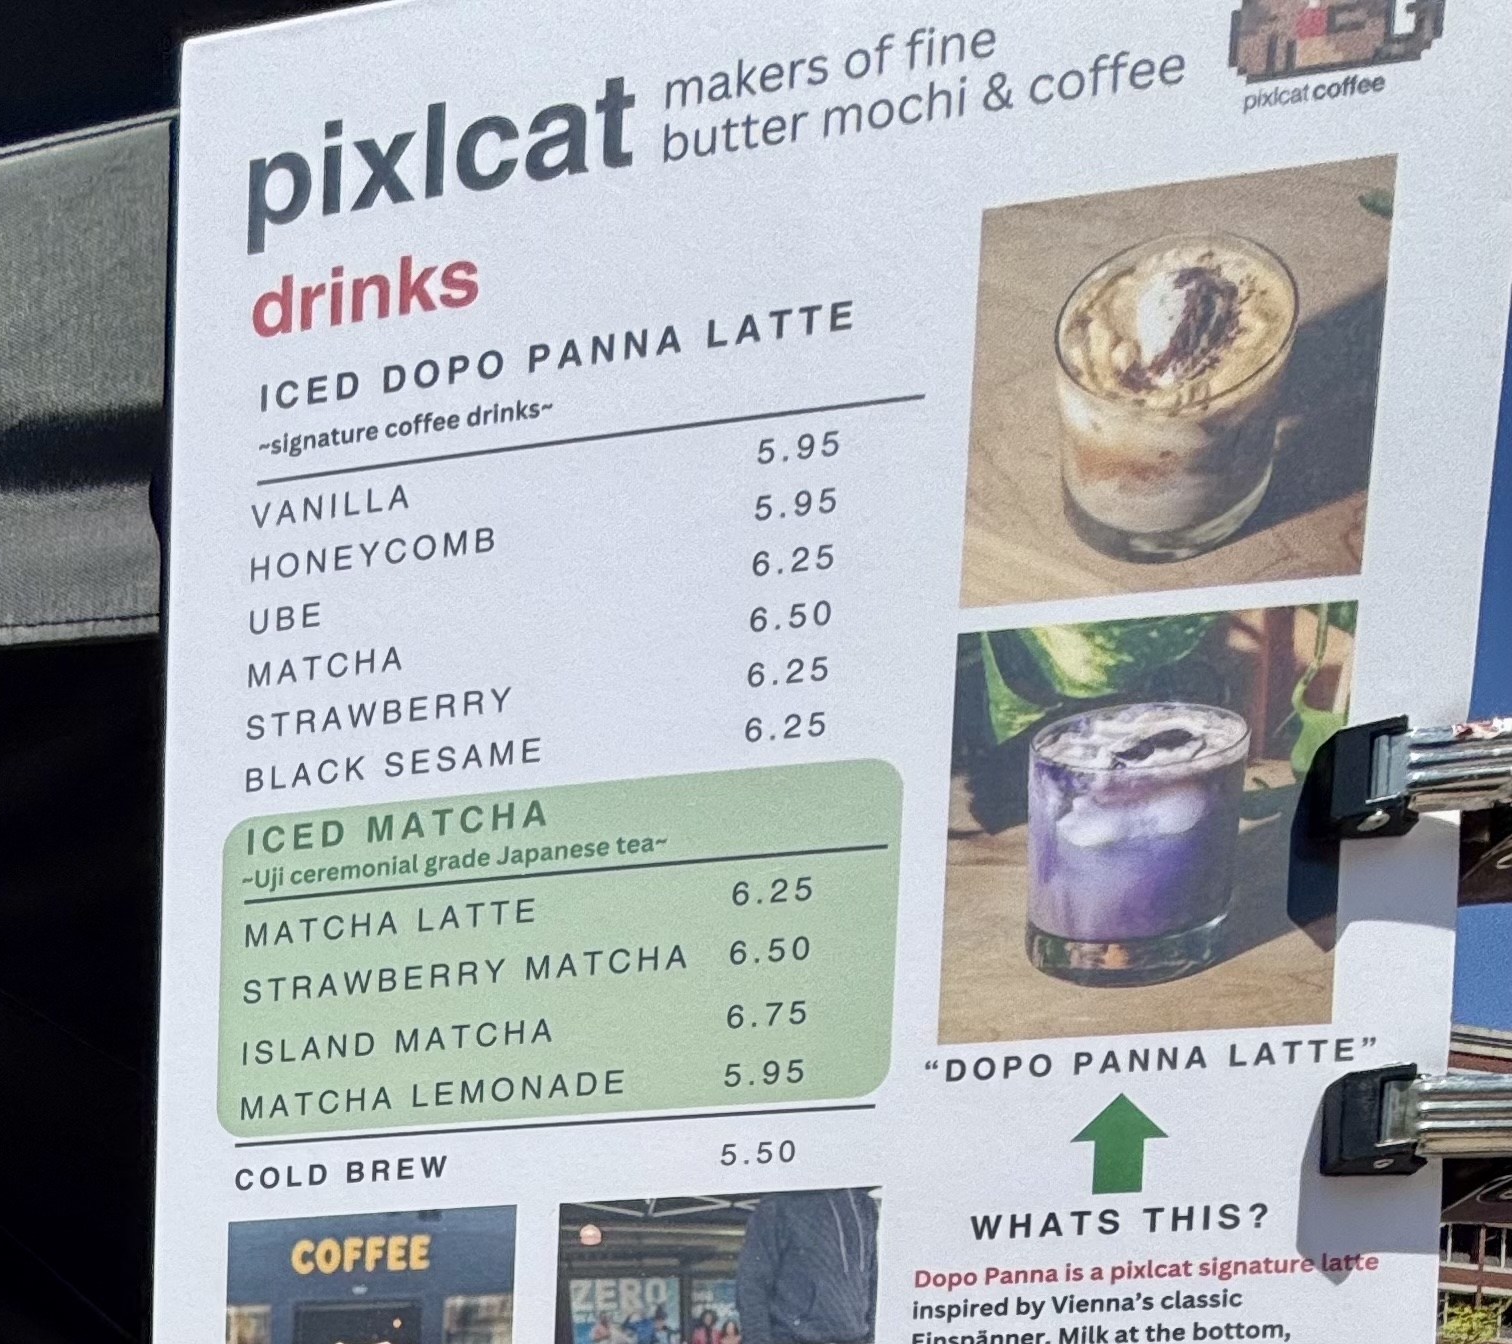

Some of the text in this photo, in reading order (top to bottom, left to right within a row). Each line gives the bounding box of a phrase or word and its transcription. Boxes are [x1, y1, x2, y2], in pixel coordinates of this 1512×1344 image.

[664, 27, 997, 111] makers of fine
[662, 53, 1186, 164] butter mochi & coffee
[246, 75, 636, 256] pixlcat
[252, 254, 479, 338] drinks
[260, 299, 854, 413] ICED DOPO PANNA LATTE
[384, 411, 461, 439] coffee
[757, 430, 840, 465] 5.95
[250, 484, 409, 529] VANILLA
[754, 487, 837, 522] 5.95
[250, 527, 495, 583] HONEYCOMB
[752, 543, 834, 577] 6.25
[249, 601, 321, 636] UBE
[749, 599, 832, 633] 6.50
[247, 646, 402, 689] MATCHA
[747, 655, 829, 688] 6.25
[246, 686, 512, 741] STRAWBERRY
[744, 711, 826, 743] 6.25
[245, 736, 542, 794] BLACK SESAME
[246, 799, 547, 856] ICED MATCHA
[289, 852, 419, 886] ceremonial
[423, 847, 491, 878] grade
[495, 840, 611, 869] Japanese
[731, 875, 813, 907] 6.25
[244, 897, 536, 949] MATCHA LATTE
[729, 935, 810, 966] 6.50
[242, 943, 687, 1005] STRAWBERRY MATCHA
[726, 1000, 807, 1030] 6.75
[242, 1017, 553, 1067] ISLAND MATCHA
[1072, 1045, 1208, 1076] PANNA
[724, 1058, 804, 1088] 5.95
[240, 1068, 625, 1121] MATCHA LEMONADE
[234, 1154, 448, 1192] COLD BREW
[720, 1139, 796, 1167] 5.50
[969, 1201, 1269, 1241] WHATS THIS?
[291, 1234, 431, 1275] COFFEE
[914, 1269, 978, 1293] Dopo
[984, 1266, 1059, 1286] Panna
[1064, 1262, 1085, 1283] is
[1089, 1265, 1105, 1282] a
[1198, 1257, 1315, 1283] signature
[1320, 1252, 1381, 1274] latte
[912, 1296, 1010, 1324] inspired
[1015, 1295, 1047, 1321] by
[1159, 1287, 1243, 1311] classic
[1113, 1325, 1140, 1344] at
[1144, 1322, 1186, 1344] the
[1192, 1320, 1292, 1343] bottom,
